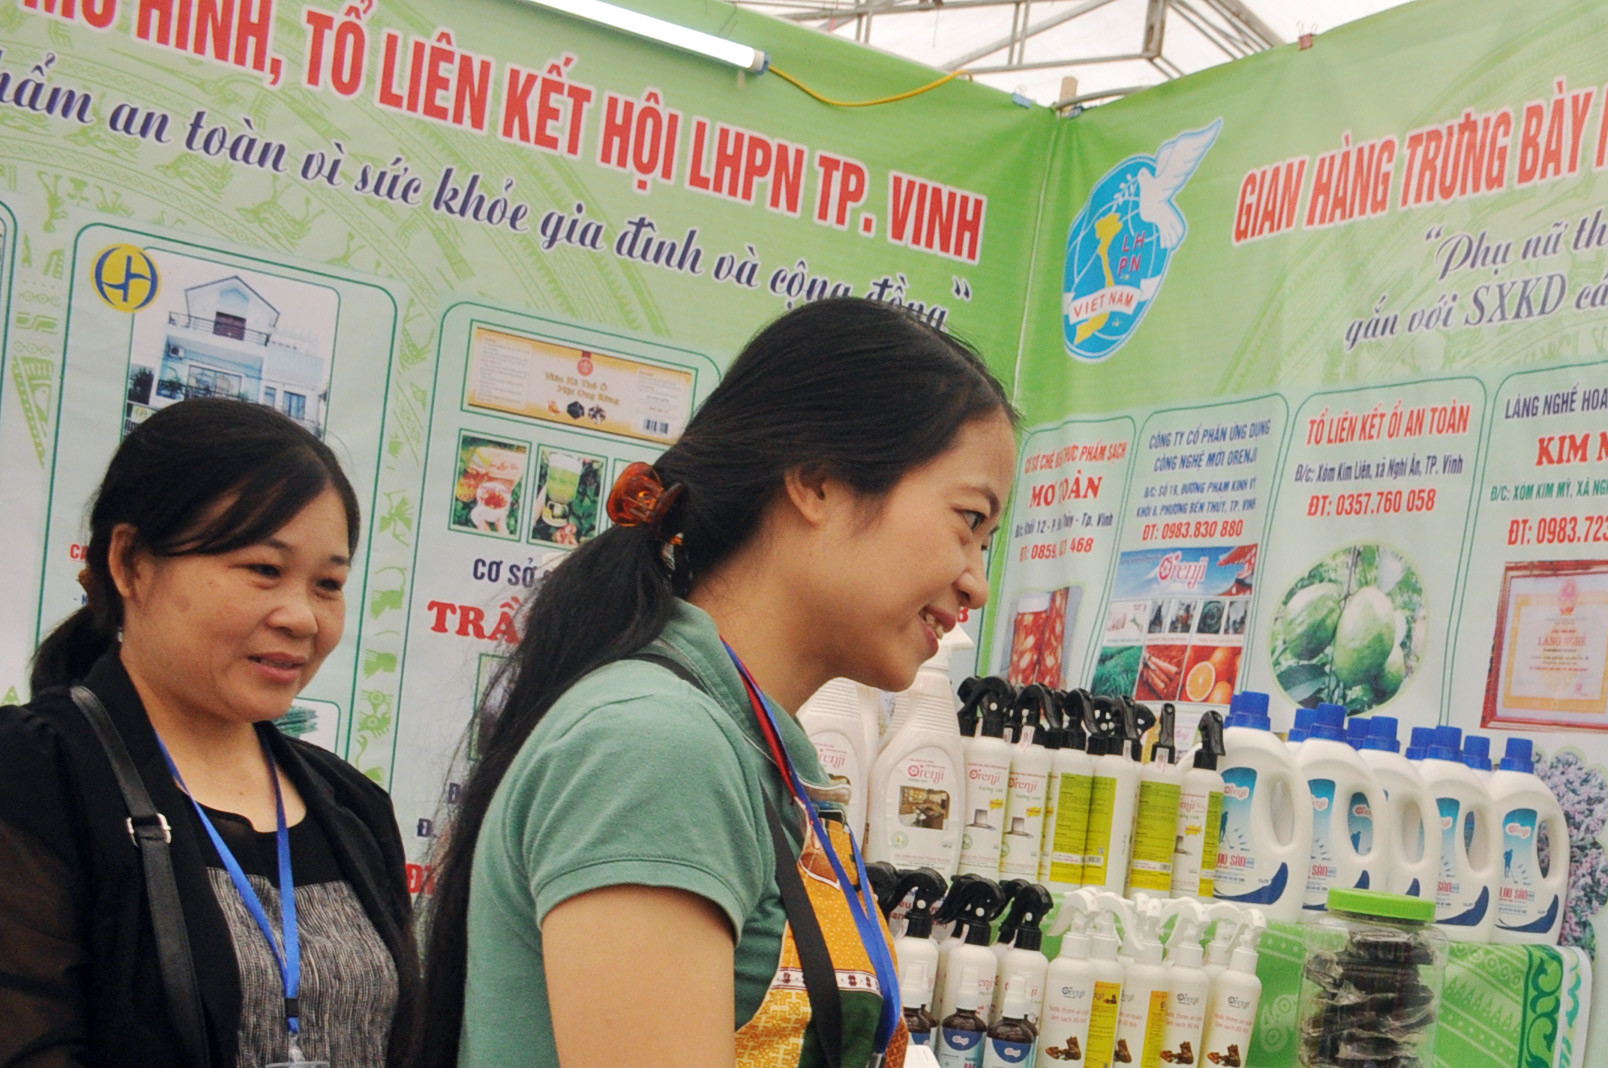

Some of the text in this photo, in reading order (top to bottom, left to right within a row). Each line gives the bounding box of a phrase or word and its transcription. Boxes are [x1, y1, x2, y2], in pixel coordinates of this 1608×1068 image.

[305, 0, 984, 260] TỔ LIÊN KẾT HỘI LHPN TP. VINH
[1234, 160, 1305, 242] GIAN
[1306, 132, 1395, 226] HÀNG
[1518, 80, 1592, 184] BÀY
[109, 102, 758, 287] an toàn vì sức khỏe gia đình và
[1521, 221, 1568, 260] nữ
[1109, 291, 1134, 307] NAM
[1345, 295, 1398, 351] gắn
[1407, 293, 1457, 331] với
[1464, 273, 1566, 326] SXKD
[1504, 393, 1538, 420] LÀNG
[1542, 382, 1579, 416] NGHỀ
[1174, 431, 1185, 446] TY
[1327, 399, 1470, 444] LIÊN KẾT ỔI AN TOÀN
[1535, 433, 1590, 466] KIM
[1335, 488, 1436, 515] 0357.760 058
[1161, 519, 1243, 539] 0983.830 880
[1508, 518, 1533, 545] ĐT:
[472, 558, 503, 582] CƠ
